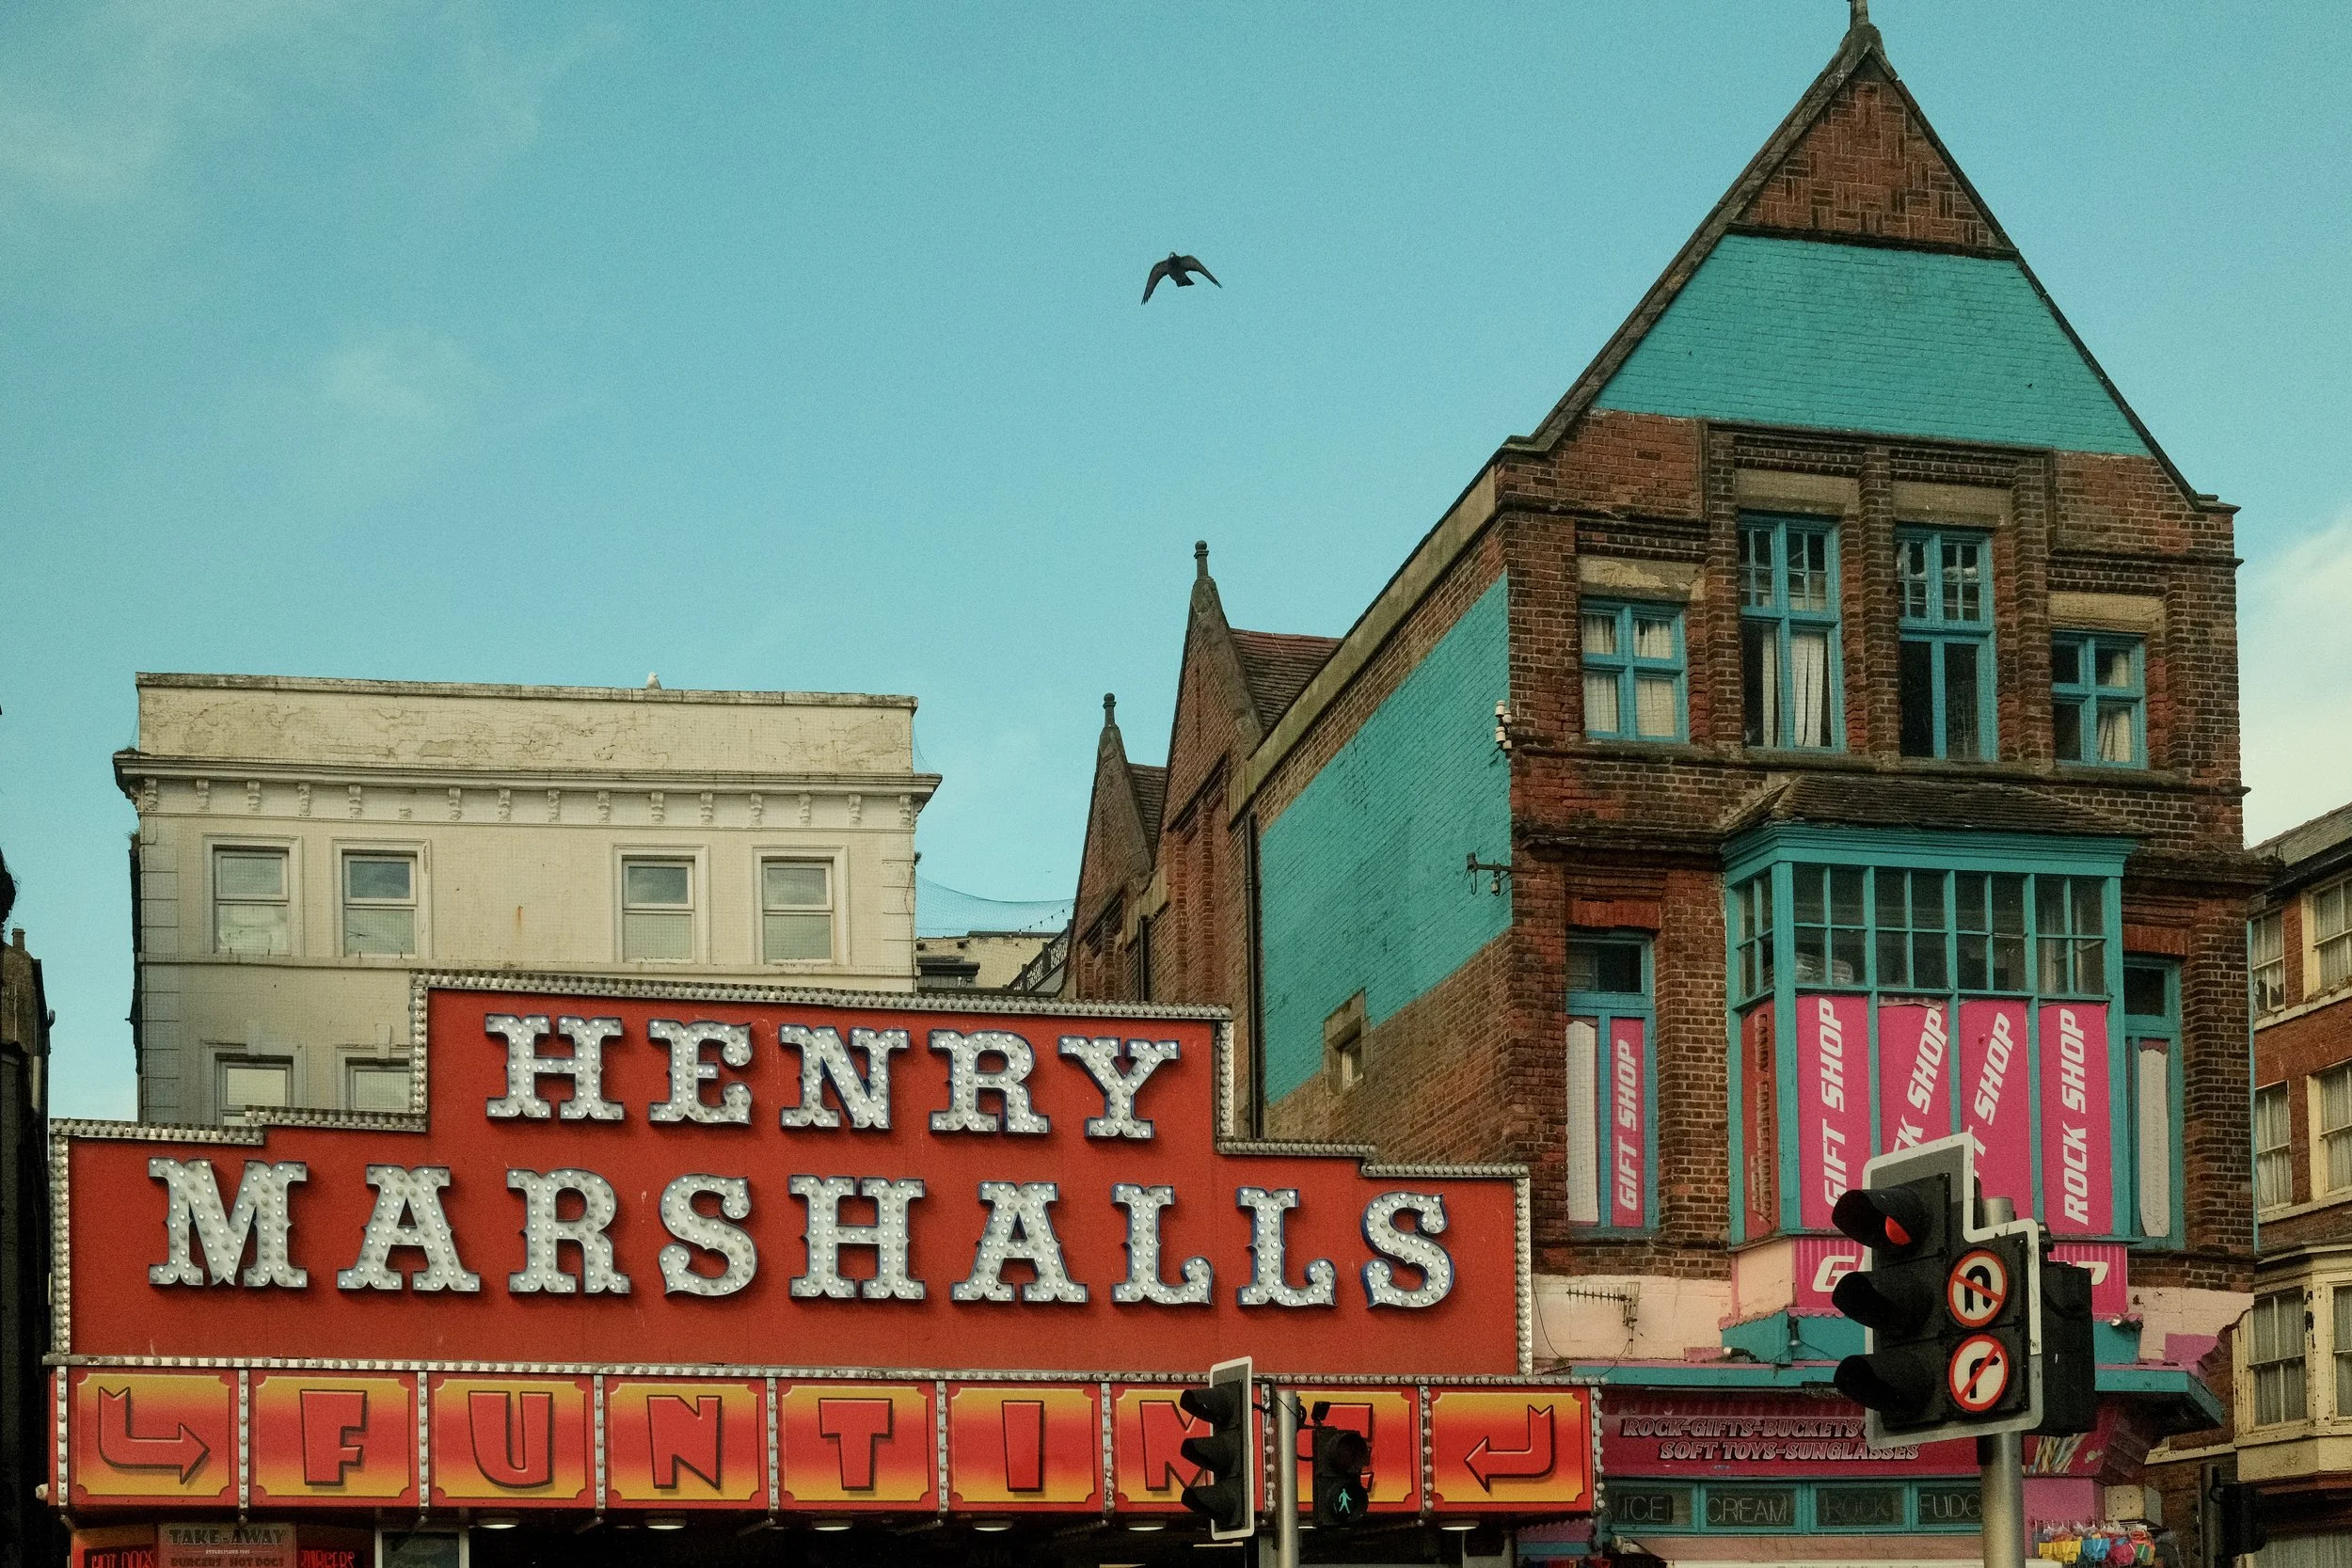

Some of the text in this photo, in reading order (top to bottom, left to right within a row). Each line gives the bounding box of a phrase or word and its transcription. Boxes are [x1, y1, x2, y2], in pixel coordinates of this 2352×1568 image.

[485, 1013, 1180, 1139] HENRY
[1819, 997, 1844, 1113] SHOP
[1907, 1007, 1947, 1115] SHOP
[1974, 1012, 2013, 1126] SHOP
[1617, 1039, 1637, 1211] GIFT SHOP
[2060, 1008, 2089, 1226] ROCK SHOP
[148, 1157, 1453, 1308] MARSHALLS
[1660, 1441, 1719, 1460] SOFT
[168, 1528, 285, 1545] TAKE-AWAY
[1623, 1496, 1664, 1521] ICE
[1707, 1495, 1787, 1523] CREAM
[1918, 1494, 1981, 1519] FUDG
